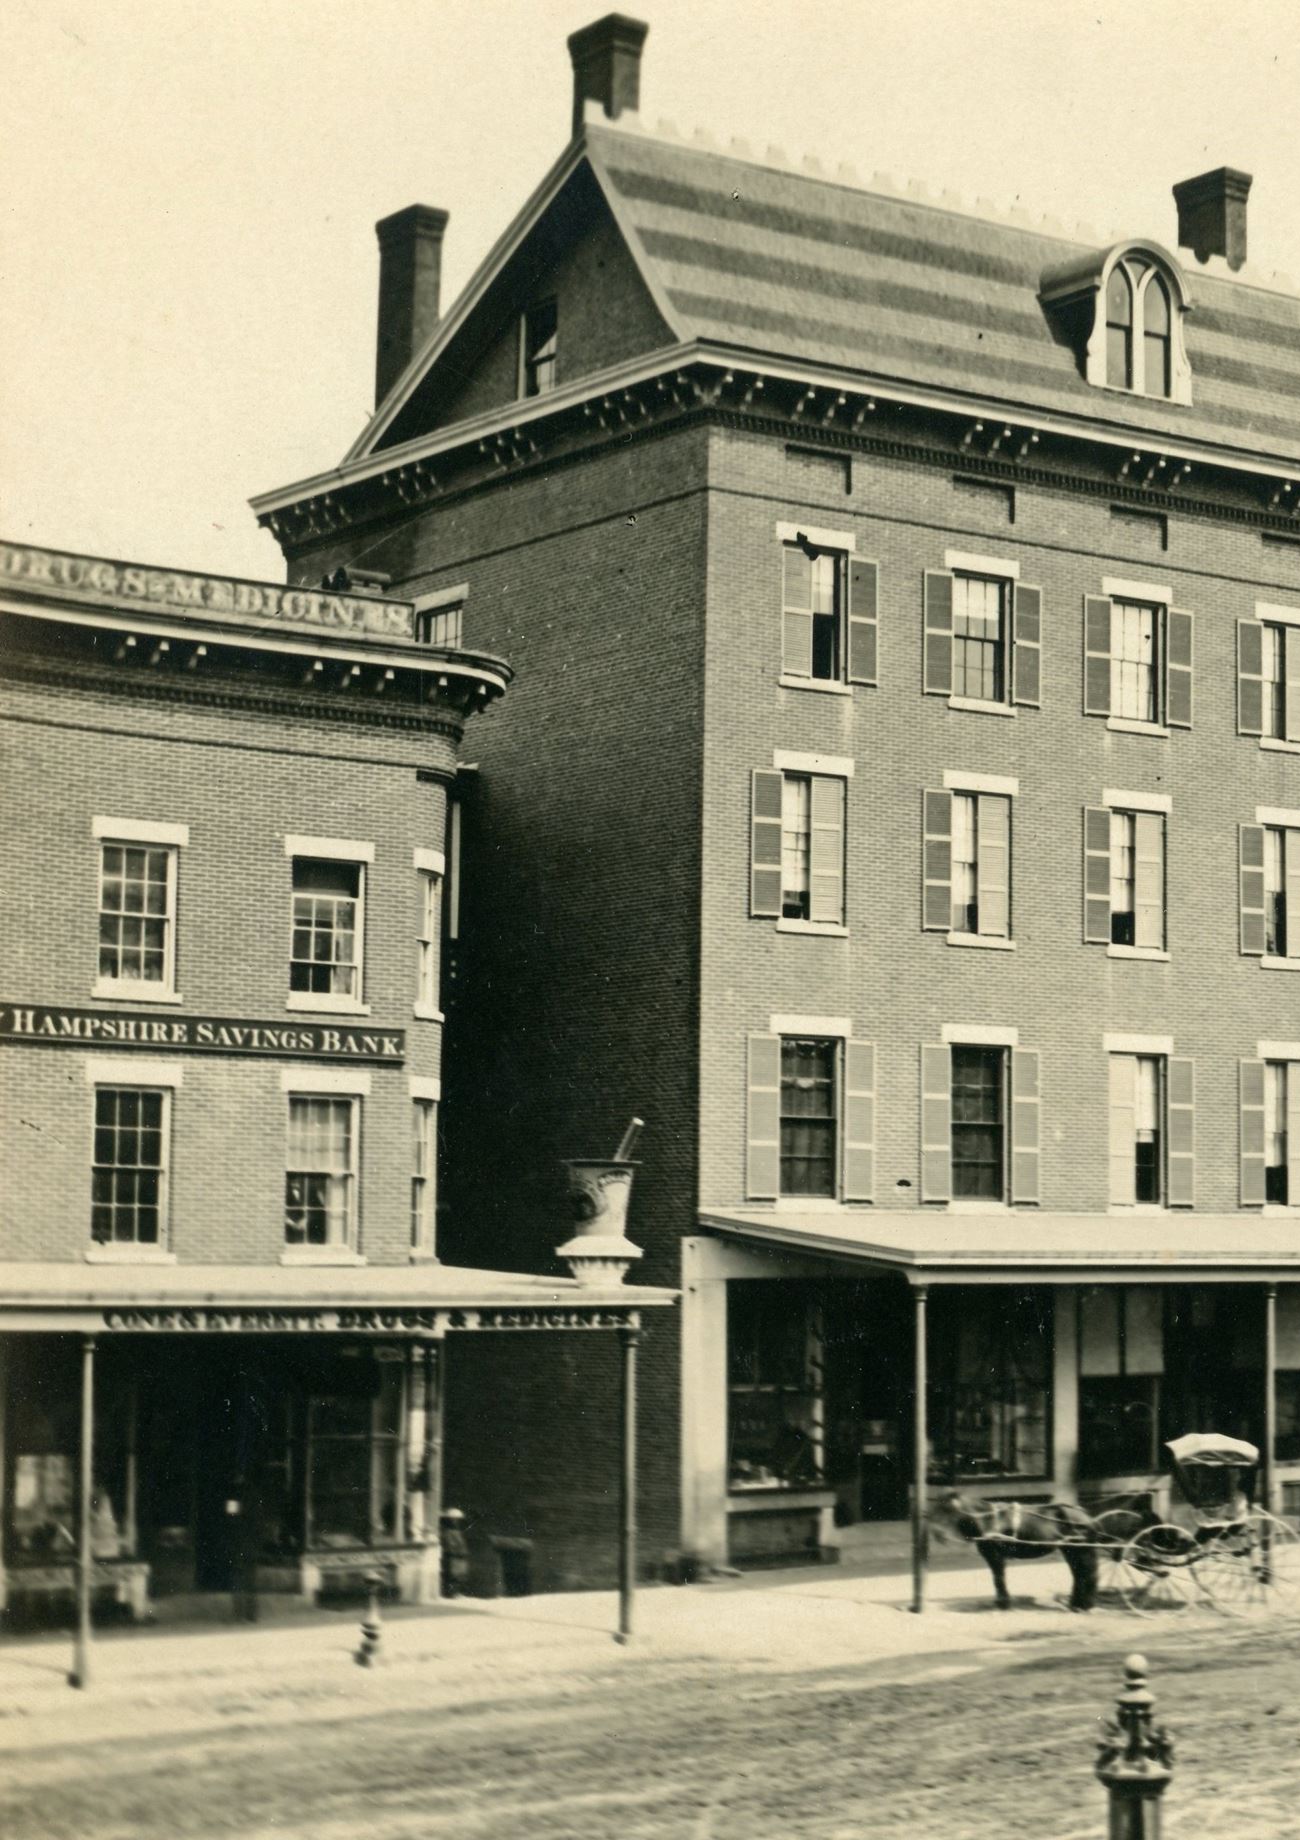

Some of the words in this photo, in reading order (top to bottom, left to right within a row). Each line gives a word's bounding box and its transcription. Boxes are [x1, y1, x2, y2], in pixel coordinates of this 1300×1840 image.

[12, 1009, 188, 1043] HAMPSHIRE
[195, 1023, 314, 1049] SAVINGS
[337, 1309, 435, 1332] DRUGS
